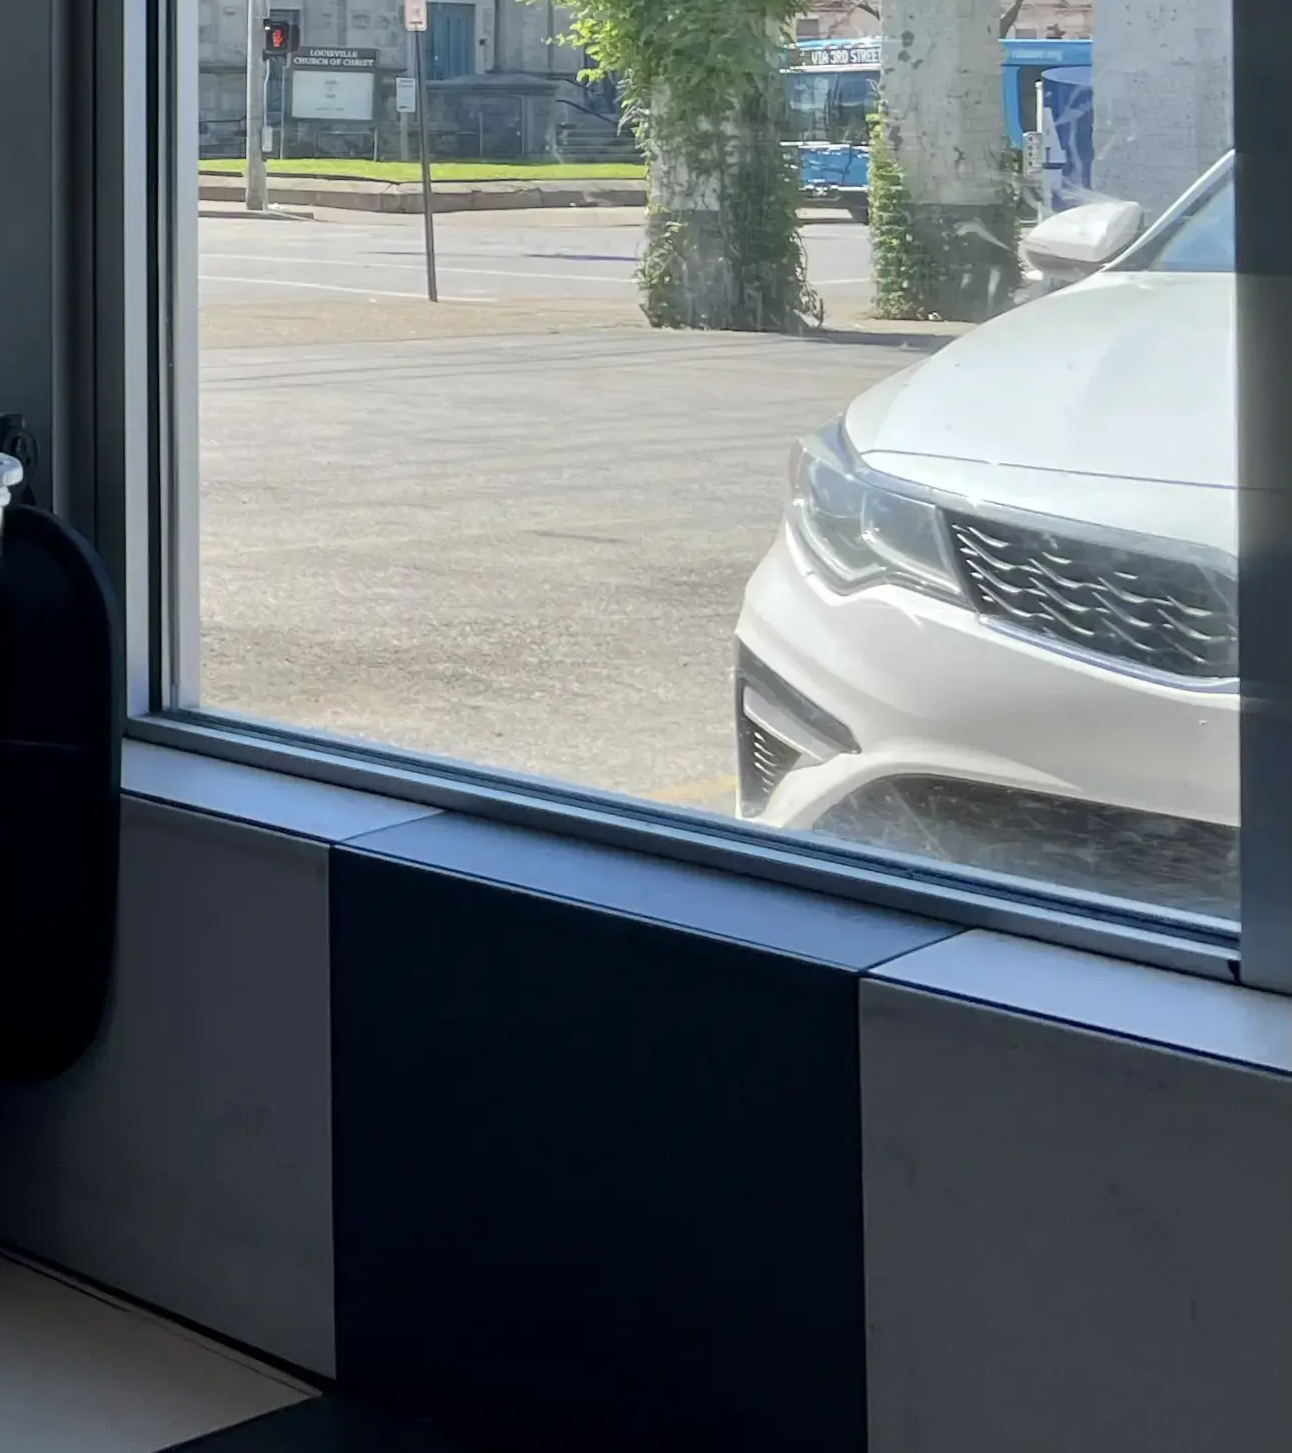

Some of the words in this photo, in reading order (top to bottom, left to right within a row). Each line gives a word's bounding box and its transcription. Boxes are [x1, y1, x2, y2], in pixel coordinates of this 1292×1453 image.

[309, 49, 358, 58] LOUISVILLE
[811, 50, 829, 65] VIA
[830, 49, 849, 64] 3RD
[293, 57, 329, 66] CHURCH
[329, 58, 341, 66] OF
[343, 58, 374, 67] CHRIST
